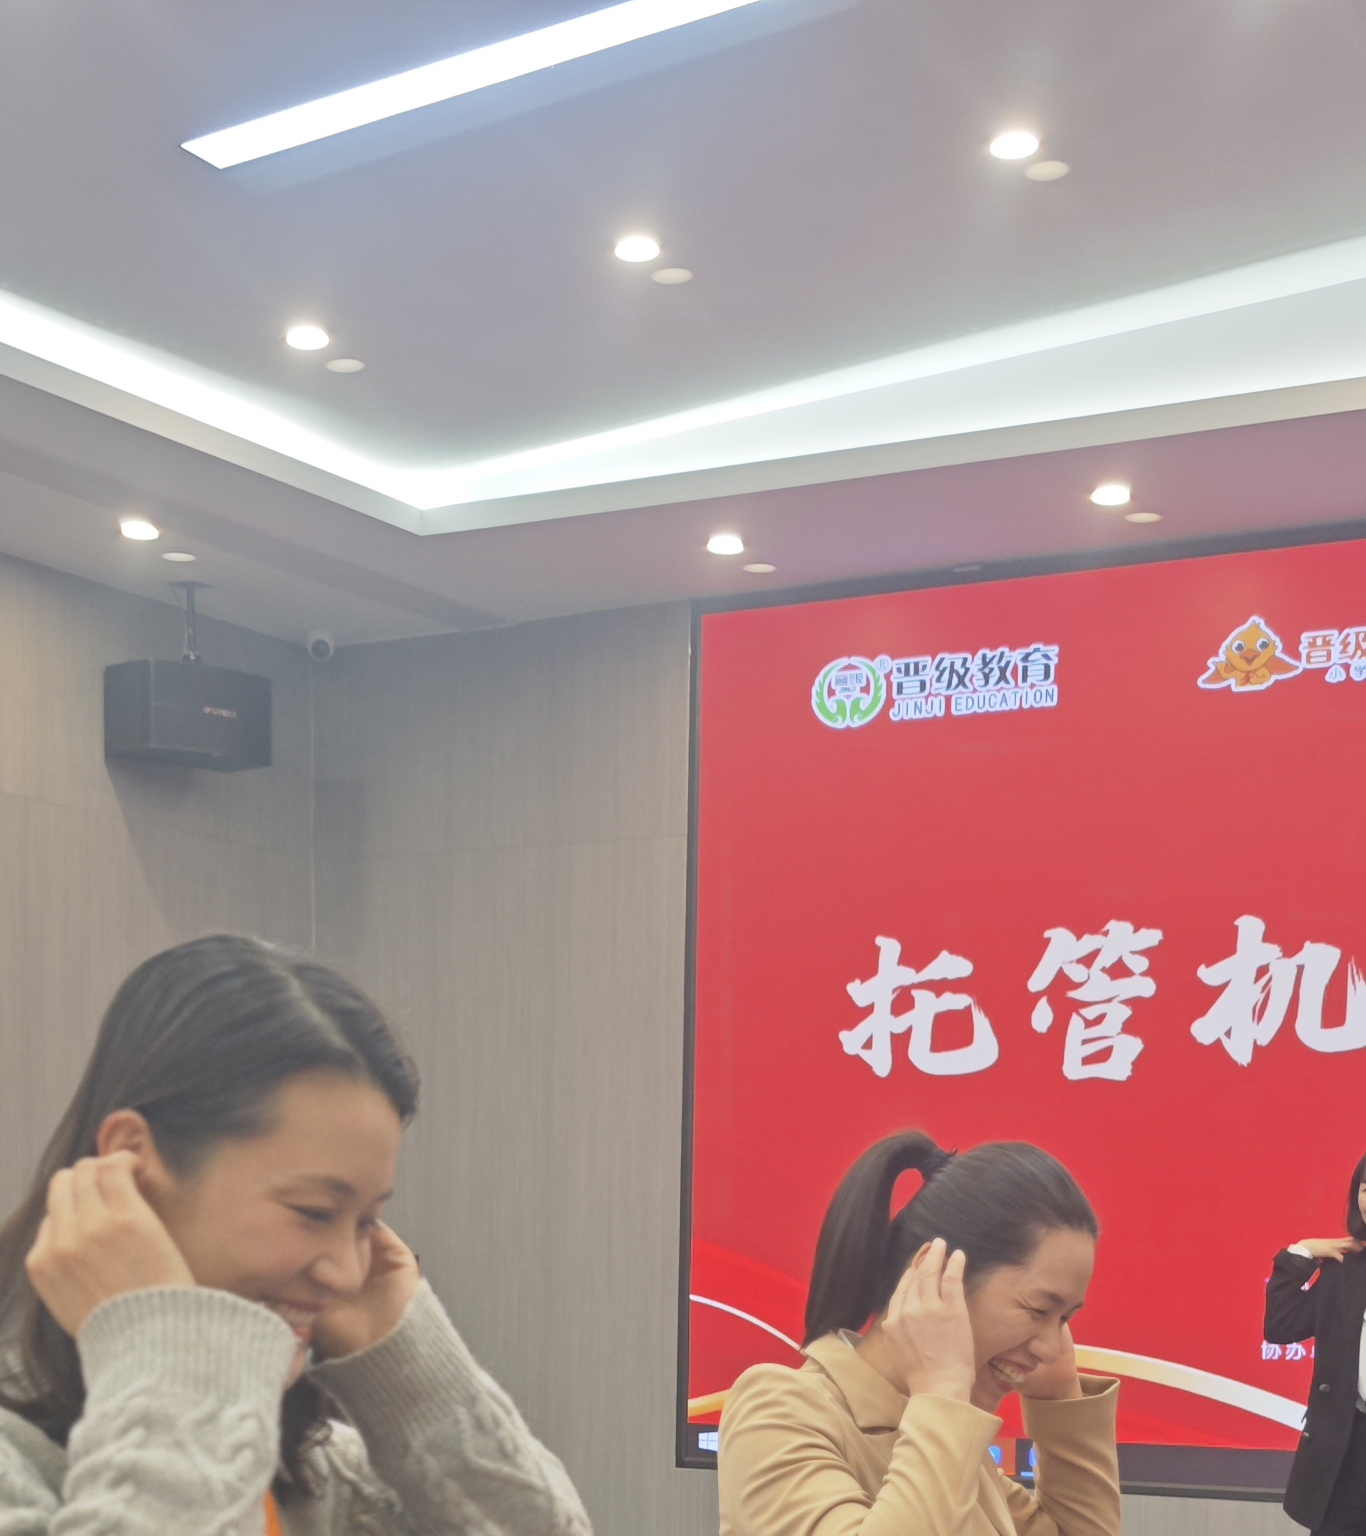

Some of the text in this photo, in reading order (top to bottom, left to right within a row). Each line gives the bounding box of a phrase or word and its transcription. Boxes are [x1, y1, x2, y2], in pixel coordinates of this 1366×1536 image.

[894, 647, 1058, 695] 晋级教育
[893, 688, 1055, 718] JINJI EDUCATION
[1261, 1342, 1315, 1361] 协办
